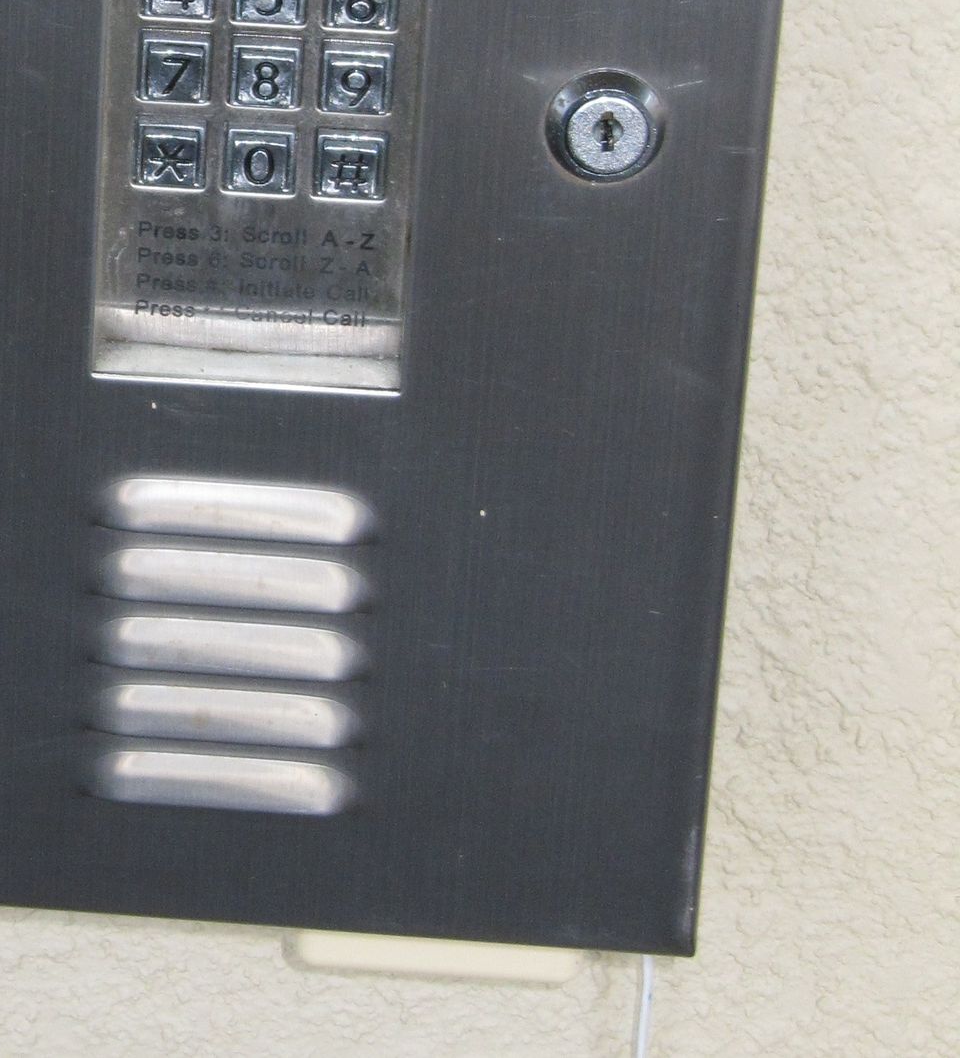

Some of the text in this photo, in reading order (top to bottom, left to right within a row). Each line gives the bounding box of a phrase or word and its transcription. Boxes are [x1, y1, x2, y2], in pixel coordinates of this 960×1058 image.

[162, 56, 372, 108] 7 8 9
[243, 147, 275, 187] 0
[138, 220, 200, 242] Press
[242, 225, 307, 246] Scroll
[137, 246, 198, 268] Press
[239, 251, 306, 272] Scroll
[136, 273, 196, 294] Press
[238, 278, 315, 301] Initiate
[326, 283, 369, 303] Call
[134, 298, 196, 318] Press
[322, 309, 366, 328] Call
